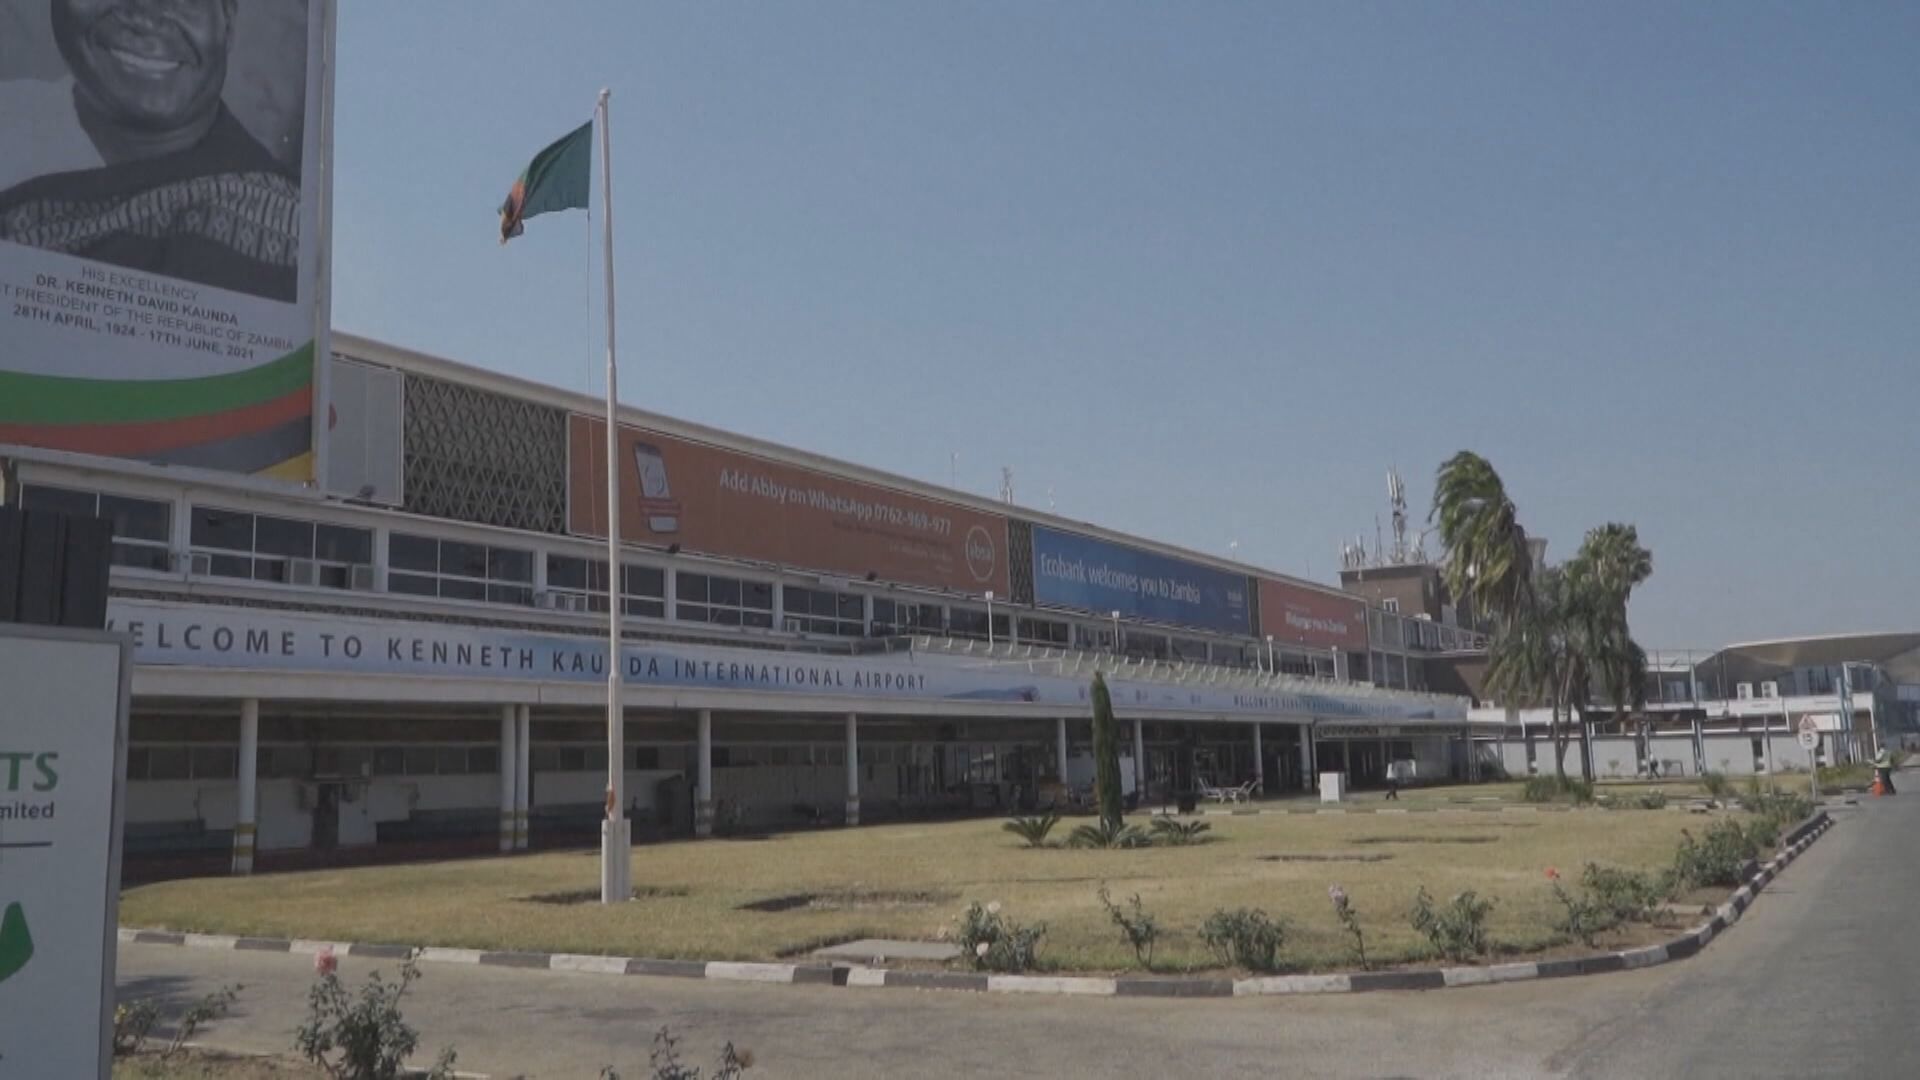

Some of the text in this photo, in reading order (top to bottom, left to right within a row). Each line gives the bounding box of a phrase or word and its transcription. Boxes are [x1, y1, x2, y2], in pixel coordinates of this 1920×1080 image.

[66, 279, 133, 304] KENNETH
[138, 295, 178, 313] DAVID
[182, 304, 238, 326] KAUNDA
[82, 266, 199, 301] HIS EXCELLENCY
[14, 303, 50, 320] 28TH
[106, 322, 135, 337] 1924
[150, 330, 181, 345] 17TH
[227, 344, 254, 359] 2021
[16, 286, 99, 313] PRESIDENT
[104, 305, 122, 317] OF
[128, 309, 153, 324] THE
[158, 315, 223, 338] REPUBLIC
[226, 329, 245, 341] OF
[247, 333, 293, 350] ZAMBIA
[720, 468, 748, 493] Add
[752, 475, 787, 505] Abby
[789, 488, 806, 504] on
[808, 488, 872, 521] WhatsApp
[1041, 553, 1087, 584] Ecobank
[1088, 563, 1138, 592] welcomes
[1140, 577, 1158, 599] you
[1160, 578, 1169, 597] to
[1170, 579, 1200, 604] Zambia
[107, 619, 925, 690] ELCOME TO KENNETH KAUDA INTERNATIONAL AIRPORT
